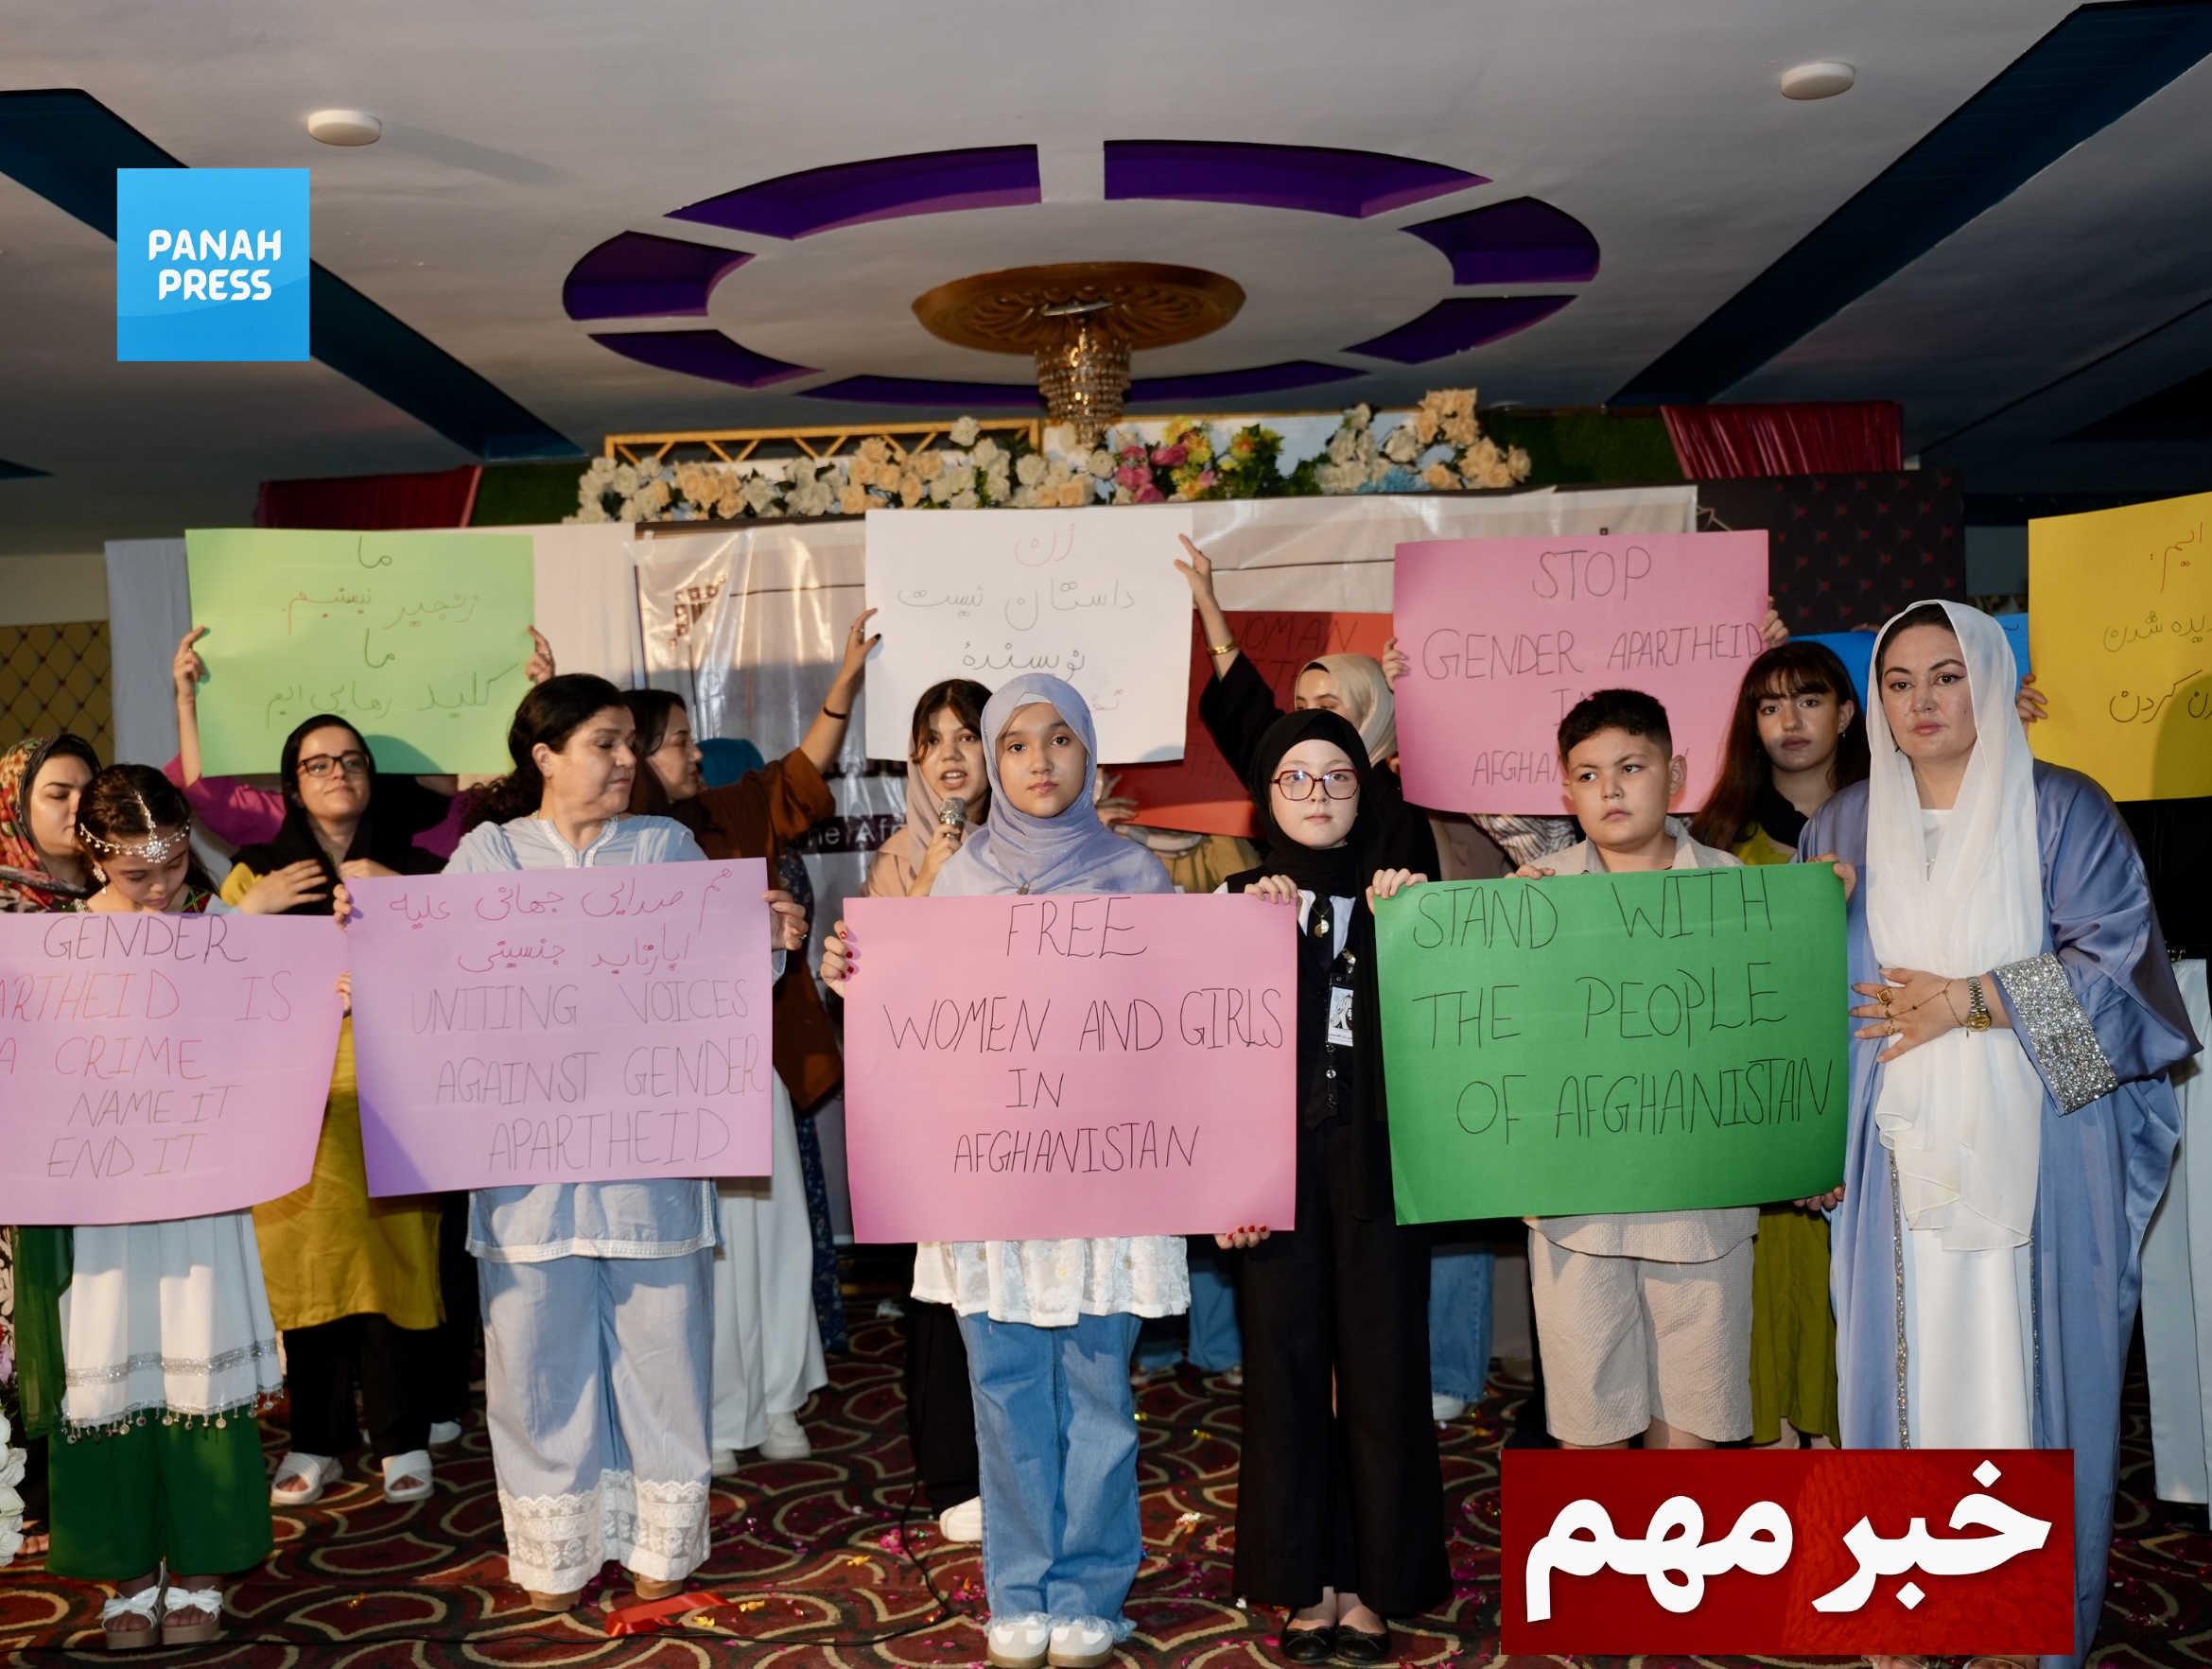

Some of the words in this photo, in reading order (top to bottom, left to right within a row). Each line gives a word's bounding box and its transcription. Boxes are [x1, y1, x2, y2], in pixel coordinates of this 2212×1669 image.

[357, 535, 392, 568] ما
[1015, 523, 1076, 567] زن
[1531, 546, 1652, 601] STOP
[897, 585, 984, 617] نیست
[1004, 577, 1135, 632] داستان
[364, 627, 395, 669] ما
[1421, 628, 1584, 680] GENDER
[1607, 622, 1764, 670] APARTHEID
[2103, 610, 2163, 652] شدن
[417, 663, 519, 719] کلید
[2109, 669, 2203, 723] کردن
[1007, 896, 1148, 959] FREE
[1413, 883, 1559, 949] STAND
[1611, 868, 1773, 938] WITH
[44, 913, 248, 964] GENDER
[235, 970, 292, 1021] IS
[411, 983, 579, 1034] UNITING
[618, 978, 749, 1024] VOICES
[882, 996, 1051, 1052] WOMEN
[1079, 999, 1163, 1052] AND
[1178, 987, 1283, 1050] GIRLS
[1412, 984, 1522, 1050] THE
[1575, 961, 1788, 1048] PEOPLE
[55, 1035, 208, 1079] CRIME
[436, 1052, 601, 1105] AGAINST
[624, 1033, 766, 1098] GENDER
[67, 1089, 174, 1127] NAME
[182, 1085, 243, 1123] IT
[1005, 1068, 1065, 1108] IN
[1455, 1074, 1526, 1145] OF
[1556, 1057, 1833, 1139] AFGHANISTAN
[47, 1136, 135, 1179] END
[143, 1133, 209, 1176] IT
[489, 1107, 731, 1173] APARTHEID
[953, 1120, 1200, 1174] AFGHANISTAN
